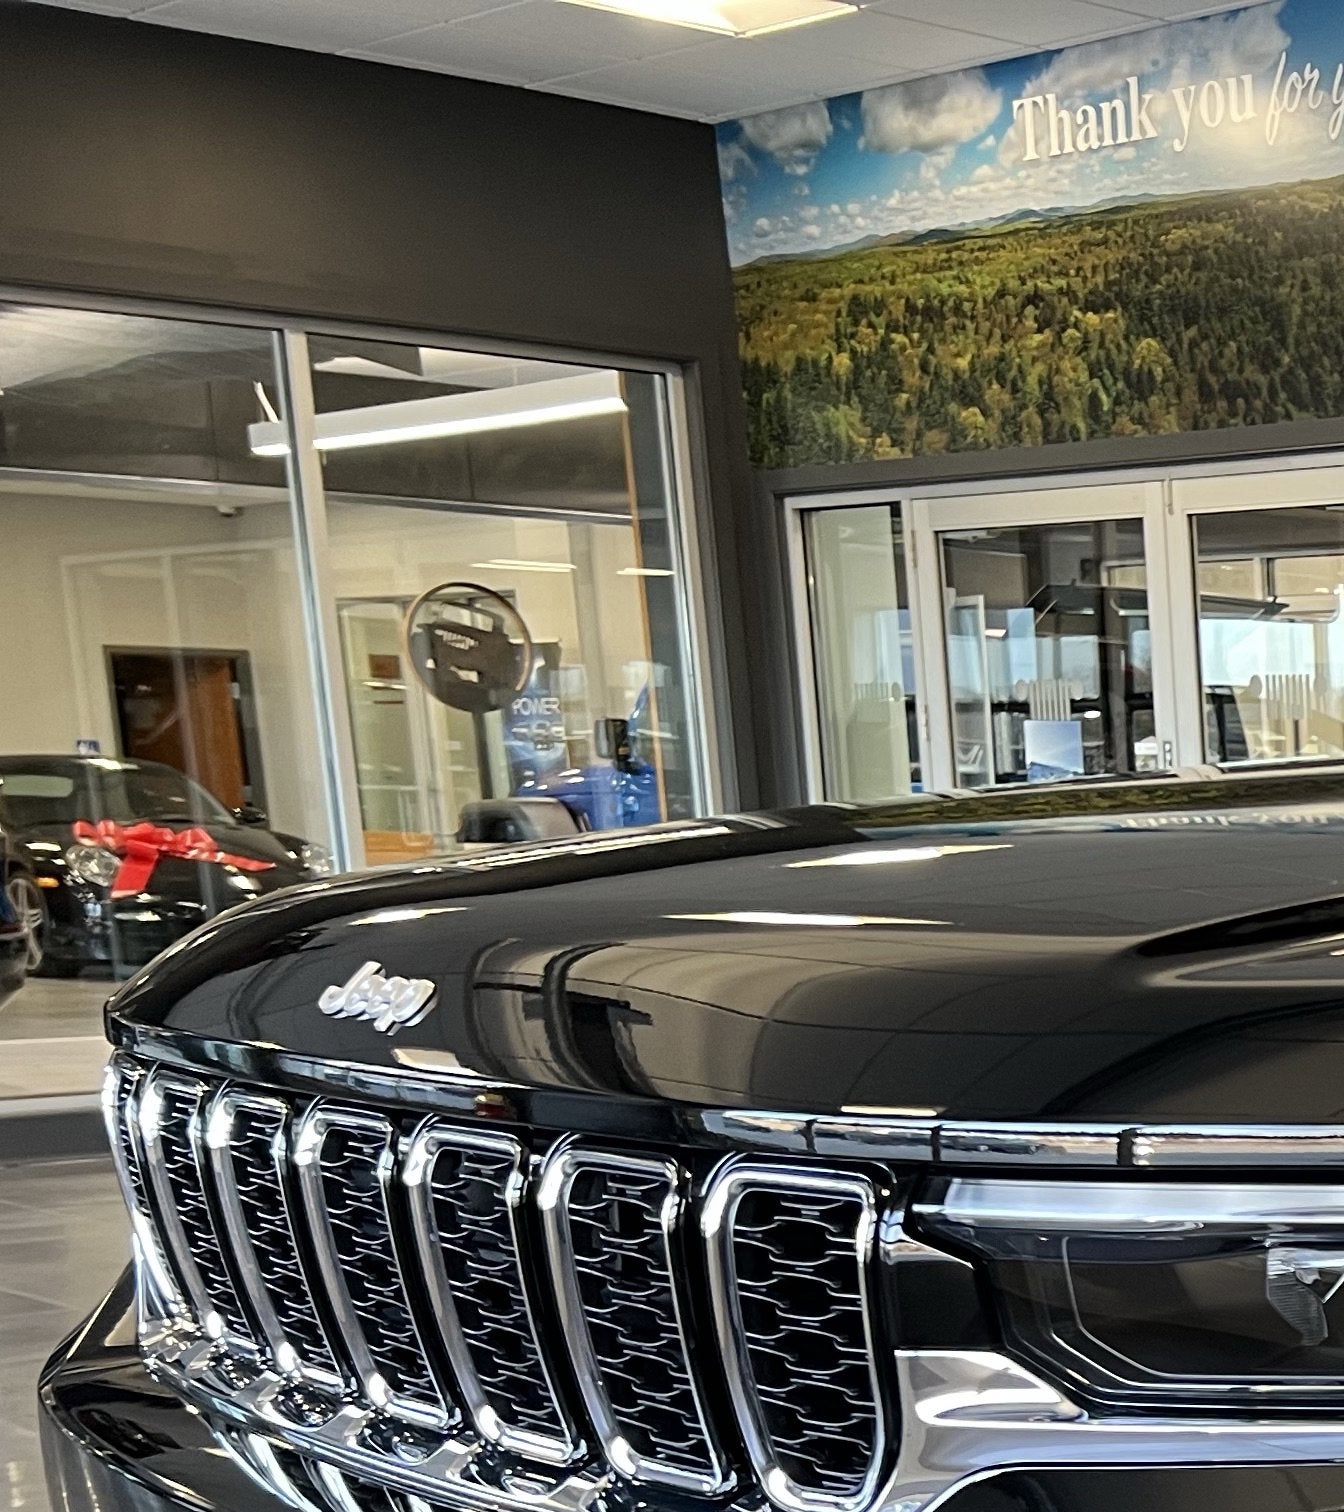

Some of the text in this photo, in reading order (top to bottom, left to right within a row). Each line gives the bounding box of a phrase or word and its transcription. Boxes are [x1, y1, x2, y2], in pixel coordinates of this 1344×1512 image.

[1012, 76, 1158, 162] Thank
[1172, 74, 1258, 153] you
[1265, 50, 1323, 146] for
[511, 697, 561, 716] POWER
[318, 960, 437, 1033] Jeep
